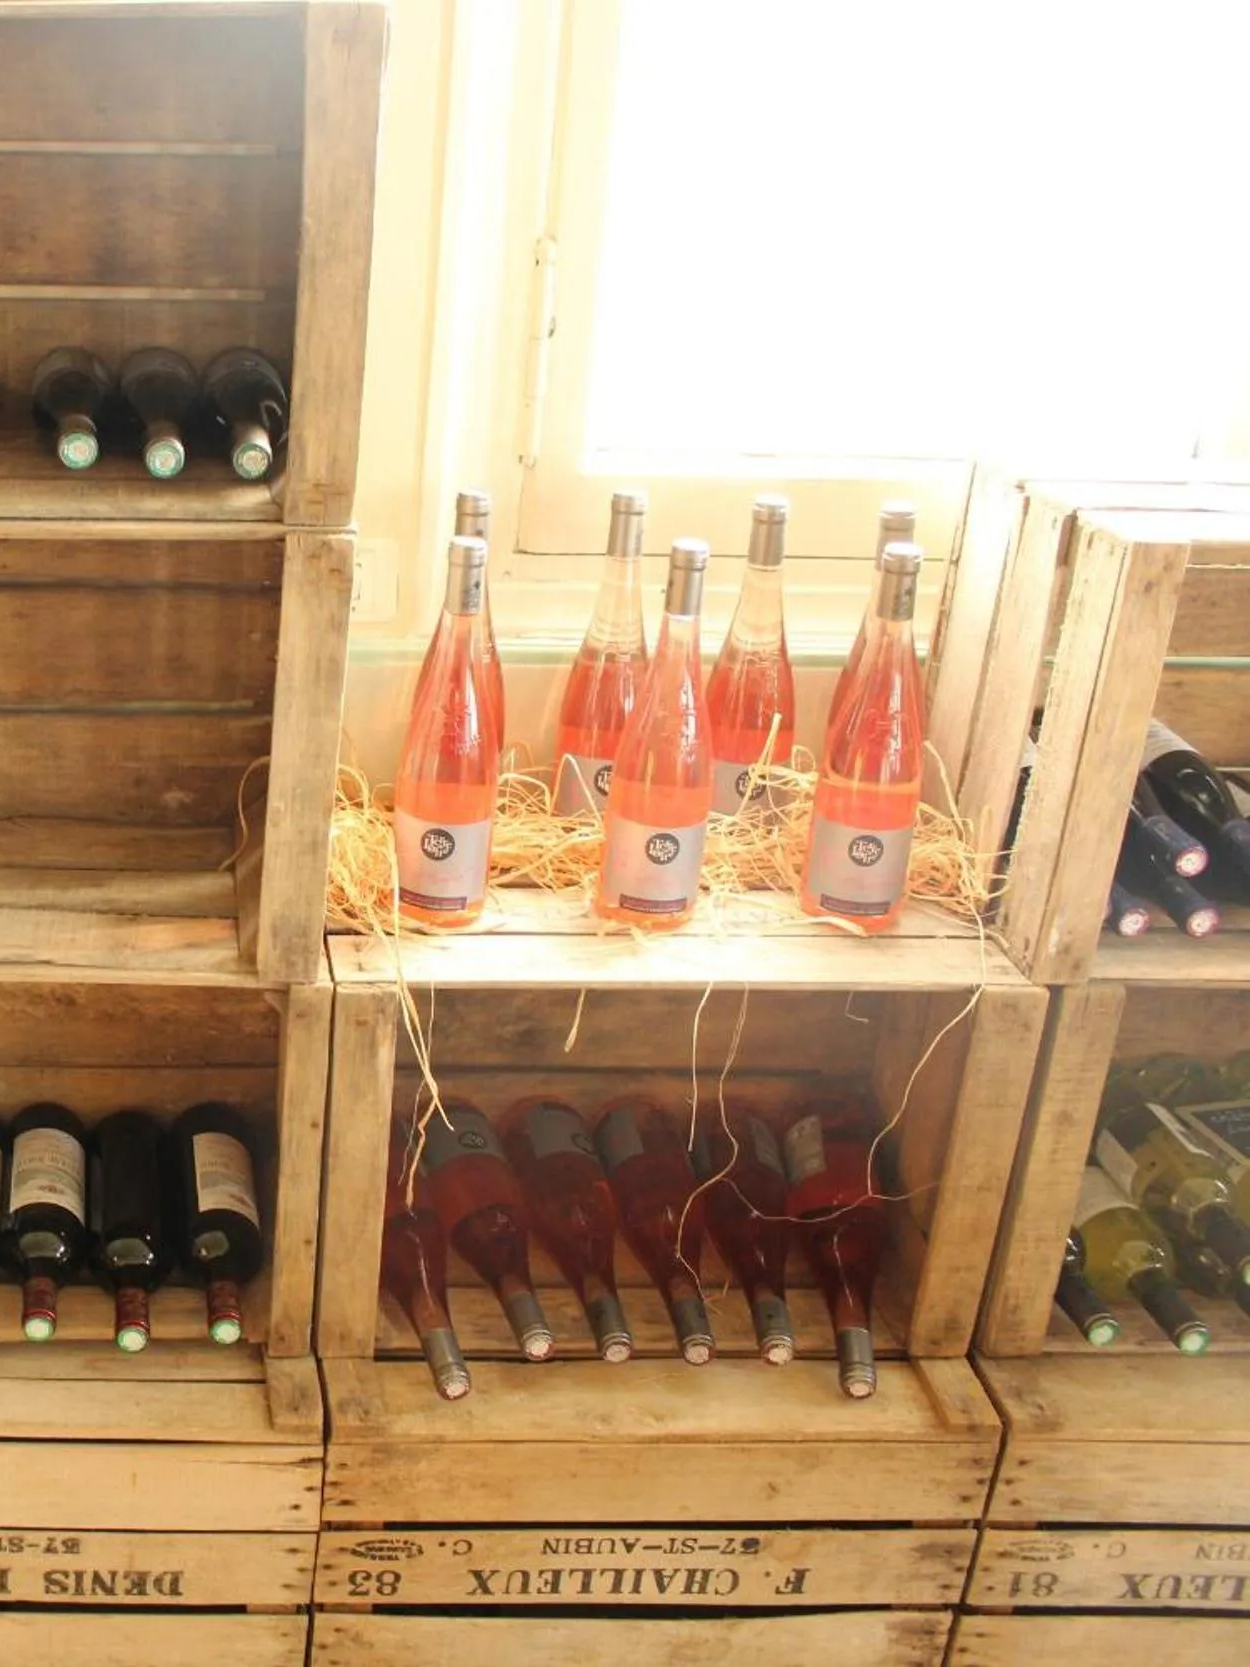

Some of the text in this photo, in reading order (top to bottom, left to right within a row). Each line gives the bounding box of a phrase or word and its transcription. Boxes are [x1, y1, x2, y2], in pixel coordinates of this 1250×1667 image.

[44, 1569, 185, 1597] DENIS
[347, 1567, 812, 1596] F. CHAILLEUX 83
[1009, 1571, 1060, 1598] 81
